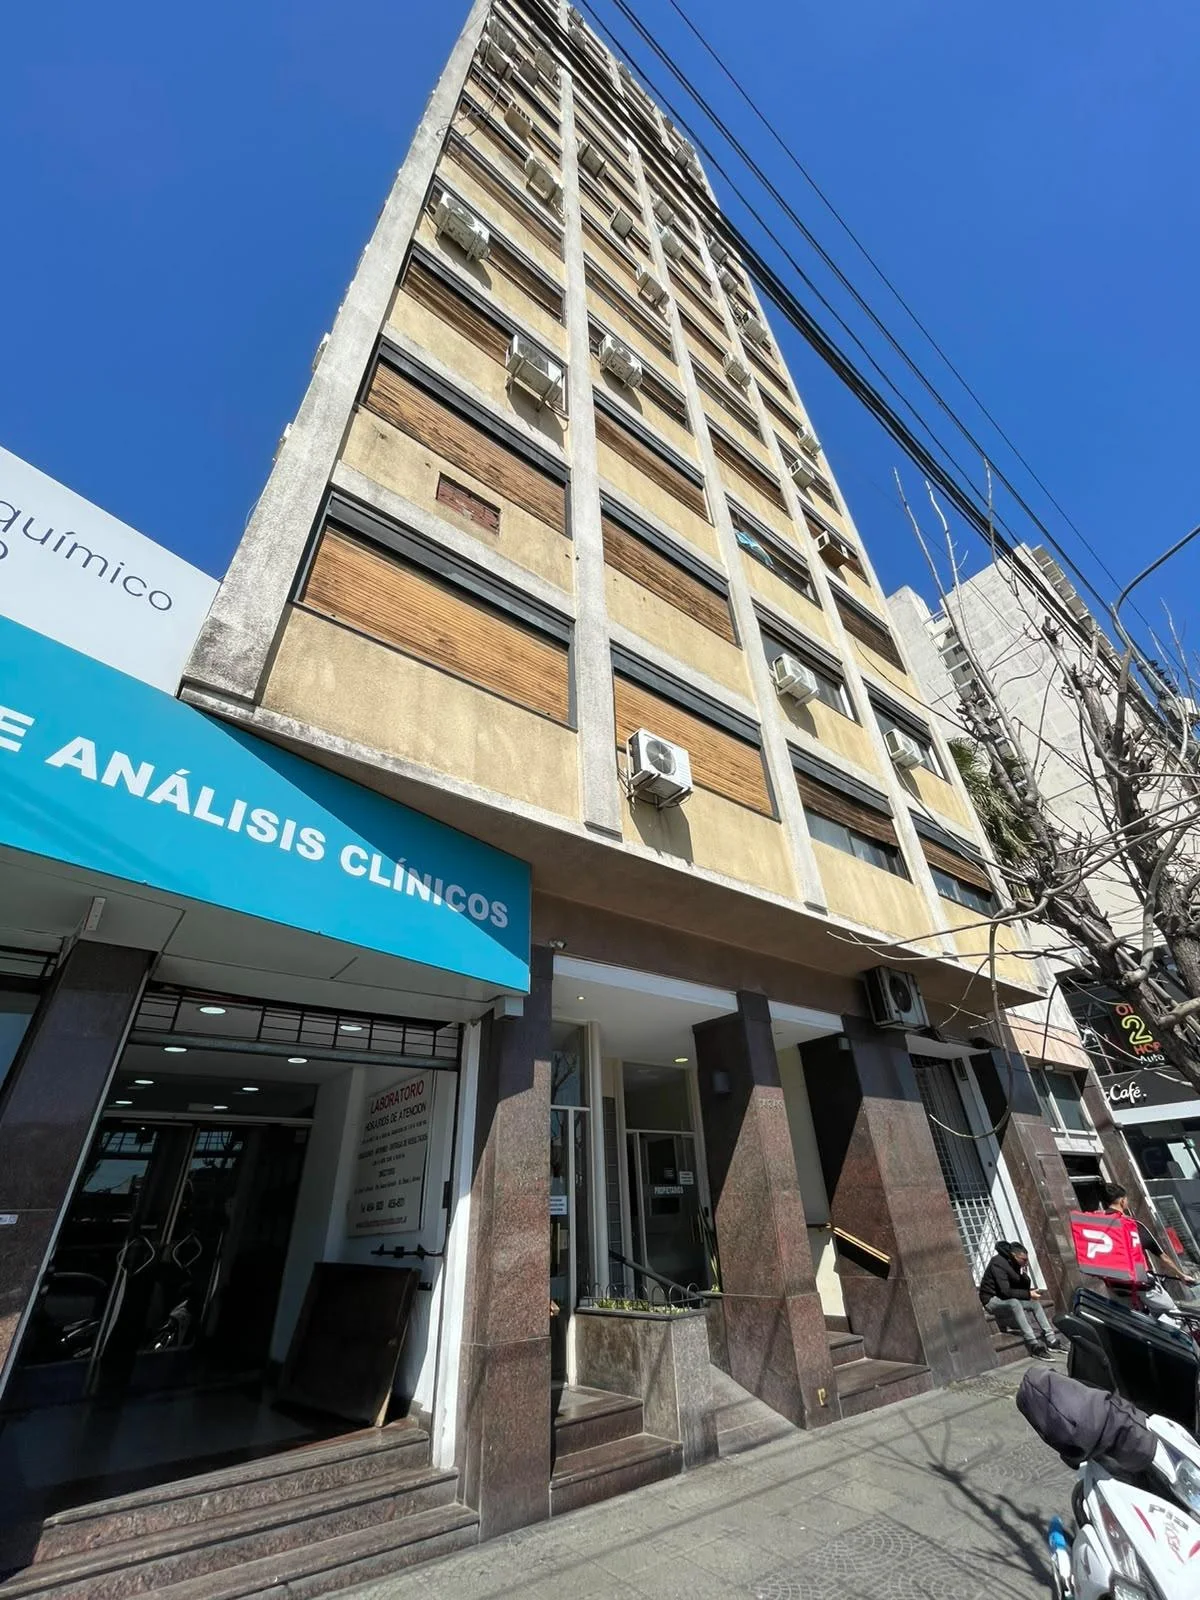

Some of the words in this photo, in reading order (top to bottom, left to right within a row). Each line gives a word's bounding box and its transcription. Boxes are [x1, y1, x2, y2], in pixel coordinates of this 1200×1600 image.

[45, 736, 327, 861] ANÁLISIS
[340, 844, 509, 928] CLÍNICOS
[371, 1079, 425, 1114] LABORATORIO
[390, 1111, 398, 1123] DE
